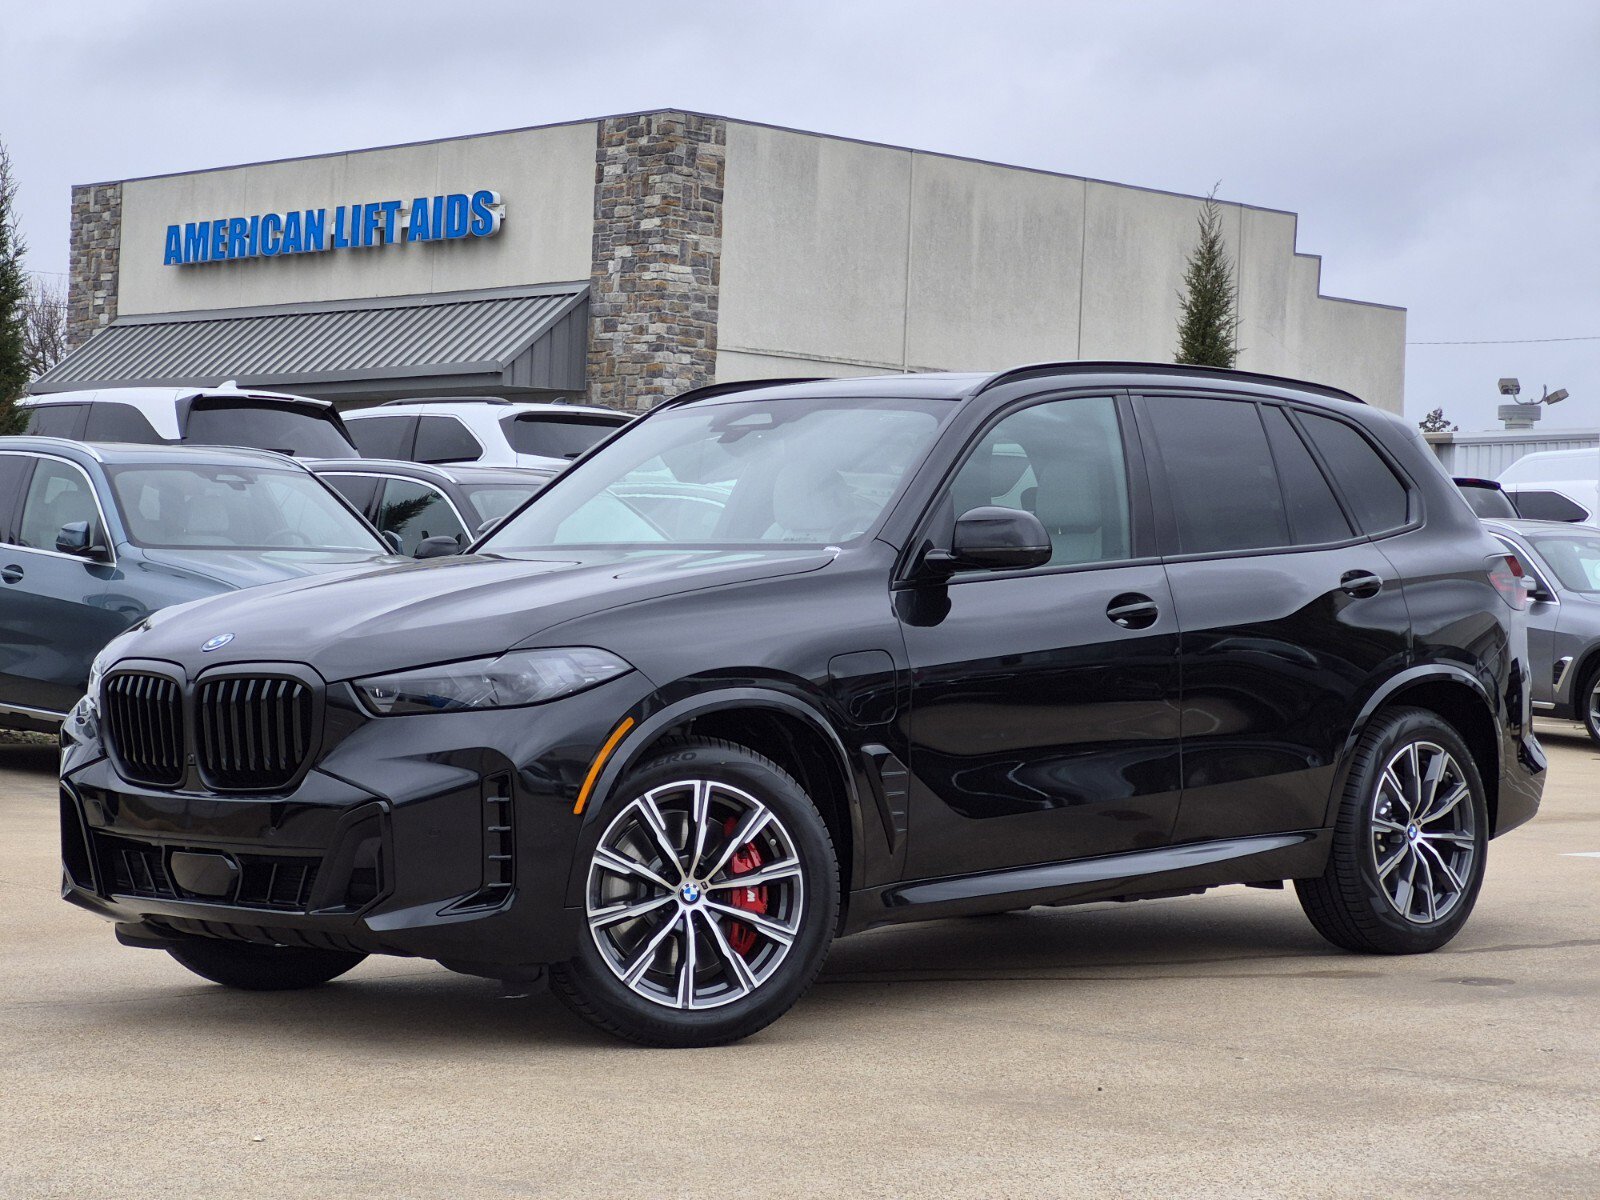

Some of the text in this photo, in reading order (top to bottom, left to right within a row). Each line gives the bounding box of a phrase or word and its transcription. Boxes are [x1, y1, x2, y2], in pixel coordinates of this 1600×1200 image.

[163, 189, 496, 266] AMERICAN LIFT AIDS
